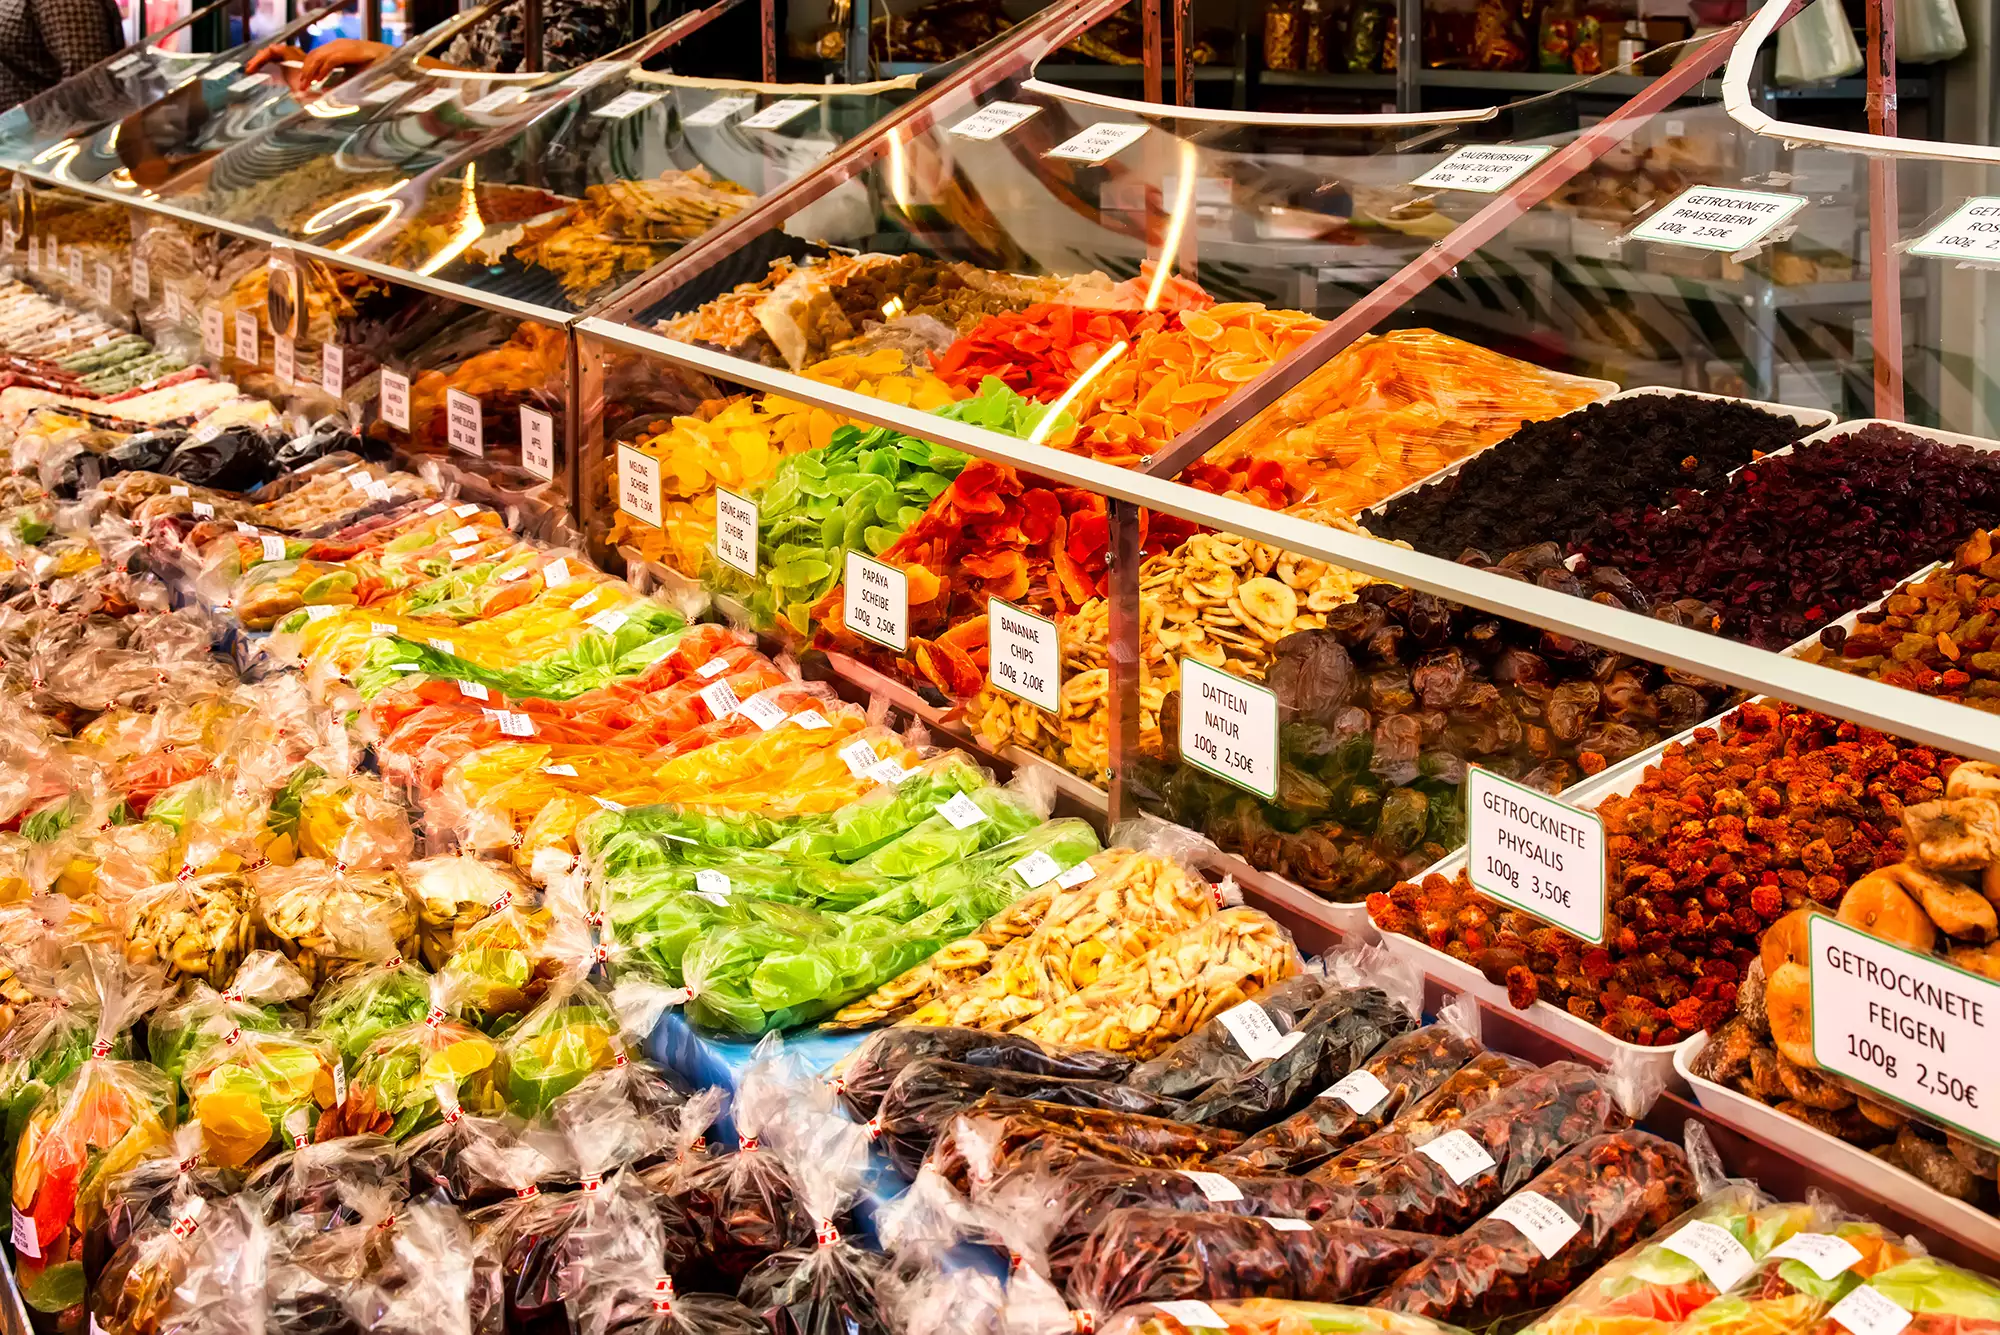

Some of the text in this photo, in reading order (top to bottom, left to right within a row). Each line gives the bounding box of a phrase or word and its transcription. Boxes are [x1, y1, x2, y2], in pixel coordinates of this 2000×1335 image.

[1443, 163, 1513, 173] OHNE ZUCKER
[1457, 151, 1534, 163] SAUERKIRSHEN
[1430, 174, 1494, 185] 100g 3,50€
[1687, 195, 1780, 214] GETROCKNETE
[1969, 206, 2000, 217] GET
[1672, 208, 1758, 227] PRAISELBERN
[1655, 221, 1733, 239] 100g 2,50€
[1936, 236, 1976, 248] 100g
[628, 460, 648, 478] MELONE
[630, 477, 649, 495] SCHEIBE
[626, 492, 654, 514] 100g 2,50€
[724, 522, 744, 542] SCHEIBE
[720, 538, 750, 563] 100g 2,50€
[862, 588, 890, 612] SCHEIBE
[854, 606, 896, 636] 100g 2,50€
[1000, 616, 1040, 644] BANANAE
[1010, 642, 1034, 665] CHIPS
[998, 660, 1046, 694] 100g 2,00€
[1202, 682, 1248, 716] DATTELN
[1204, 710, 1240, 741] NATUR
[1194, 732, 1254, 774] 100g 2,50€
[1482, 790, 1586, 850] GETROCKNETE
[1498, 828, 1564, 872] PHYSALIS
[1486, 855, 1573, 910] 100g 3,50€
[1826, 945, 1986, 1028] GETROCKNETE
[1868, 1000, 1946, 1054] FEIGEN
[1846, 1033, 1980, 1110] 100g 2,50€
